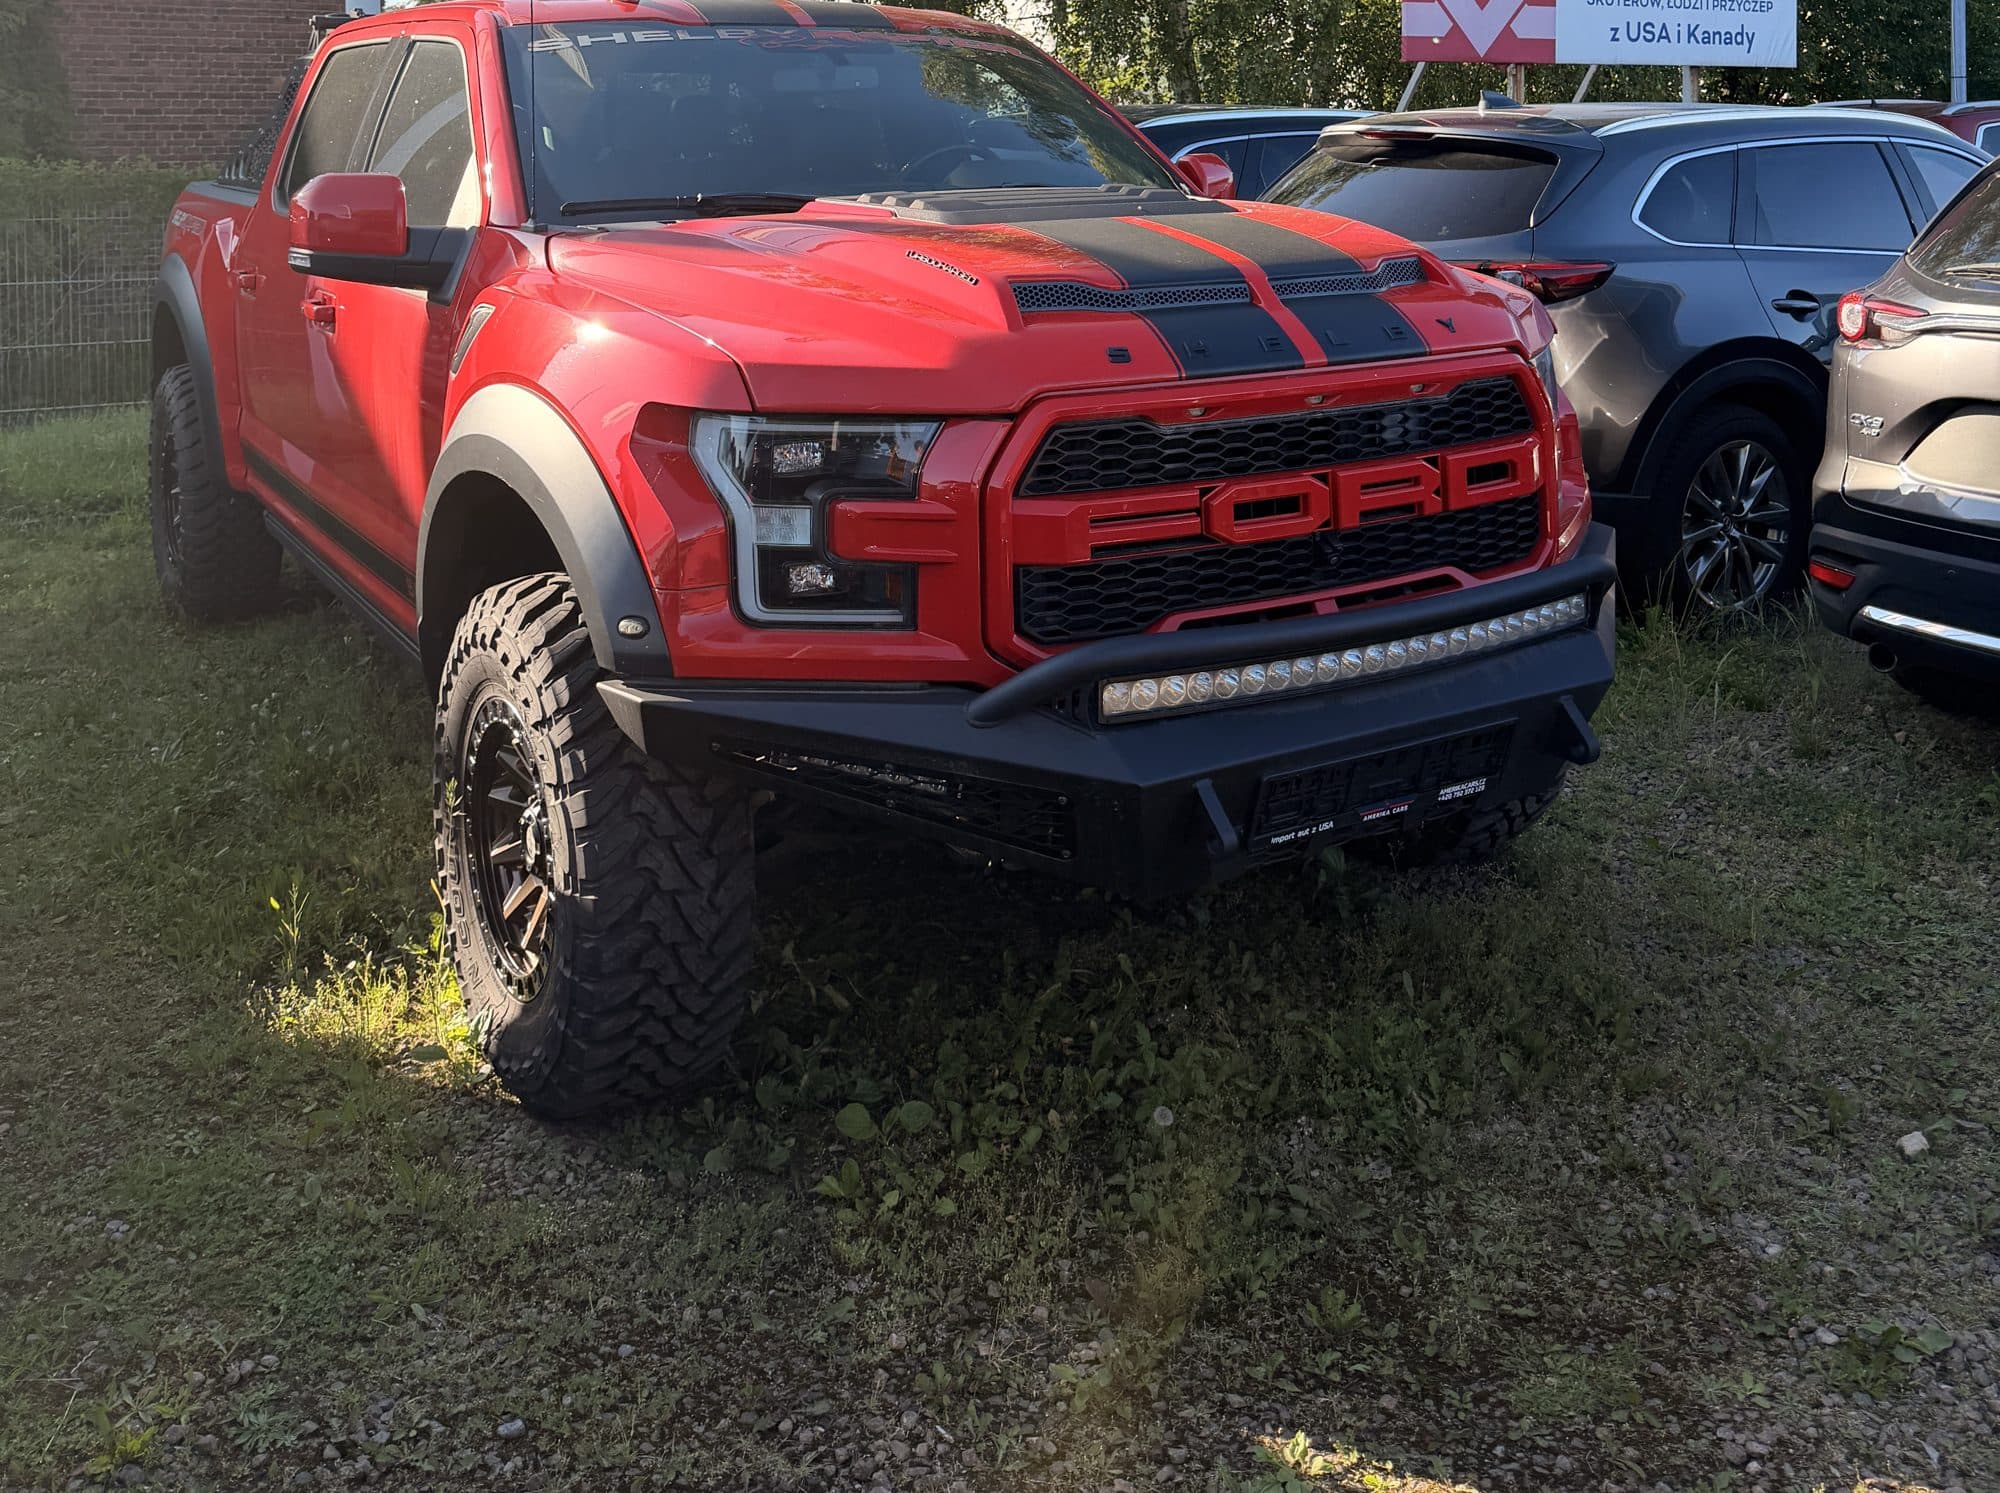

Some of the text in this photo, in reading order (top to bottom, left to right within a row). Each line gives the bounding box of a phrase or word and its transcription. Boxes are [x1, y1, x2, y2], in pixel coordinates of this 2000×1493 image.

[1712, 0, 1774, 13] PRZYCZEP
[528, 28, 800, 52] SHELBY
[1609, 21, 1756, 54] z USA i Kanady
[1106, 317, 1456, 364] SHELBY
[1013, 437, 1541, 565] FORD
[1318, 820, 1334, 832] USA
